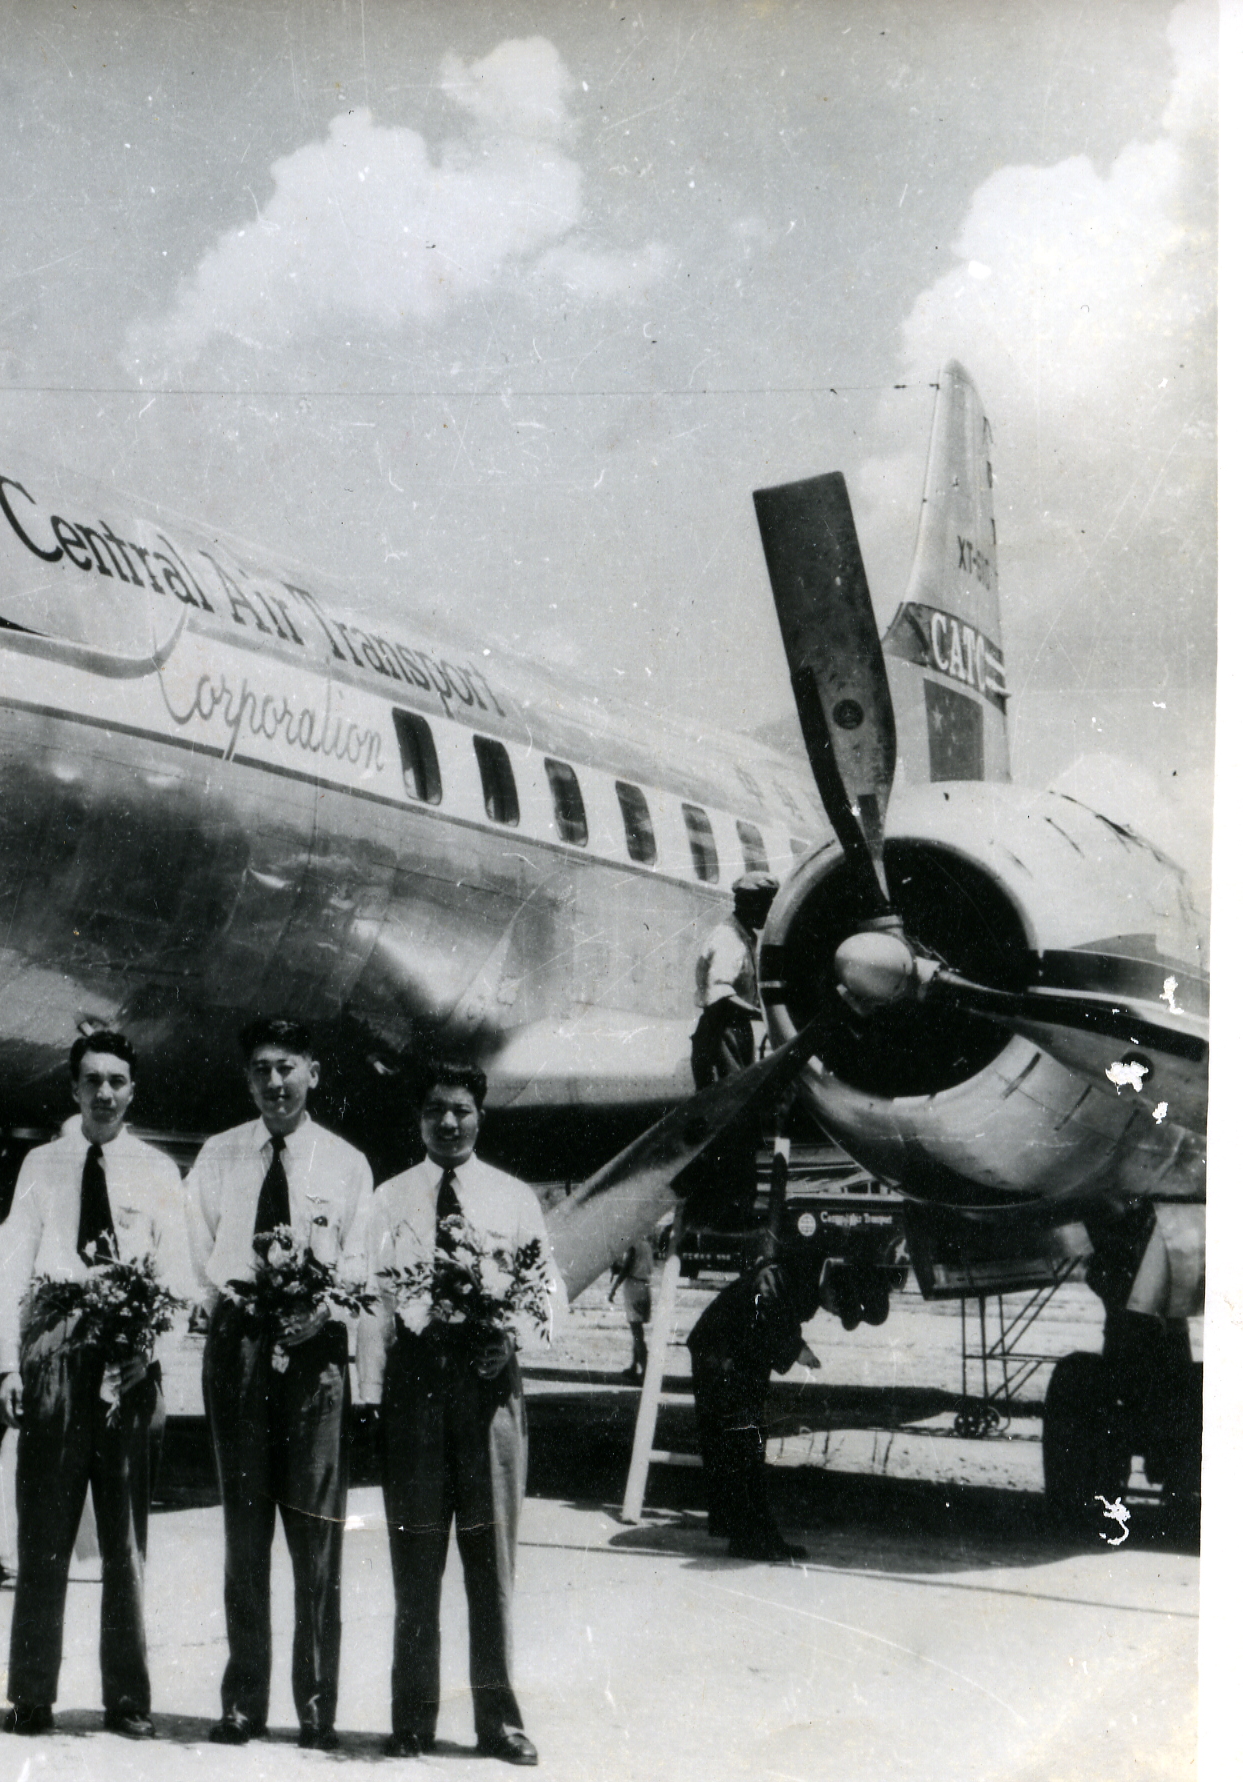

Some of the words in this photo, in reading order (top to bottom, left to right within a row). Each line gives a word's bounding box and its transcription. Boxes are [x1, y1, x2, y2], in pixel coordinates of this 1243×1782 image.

[198, 550, 305, 645] Air
[283, 580, 506, 720] Transport
[930, 611, 987, 691] CATC
[156, 664, 386, 771] Corporation
